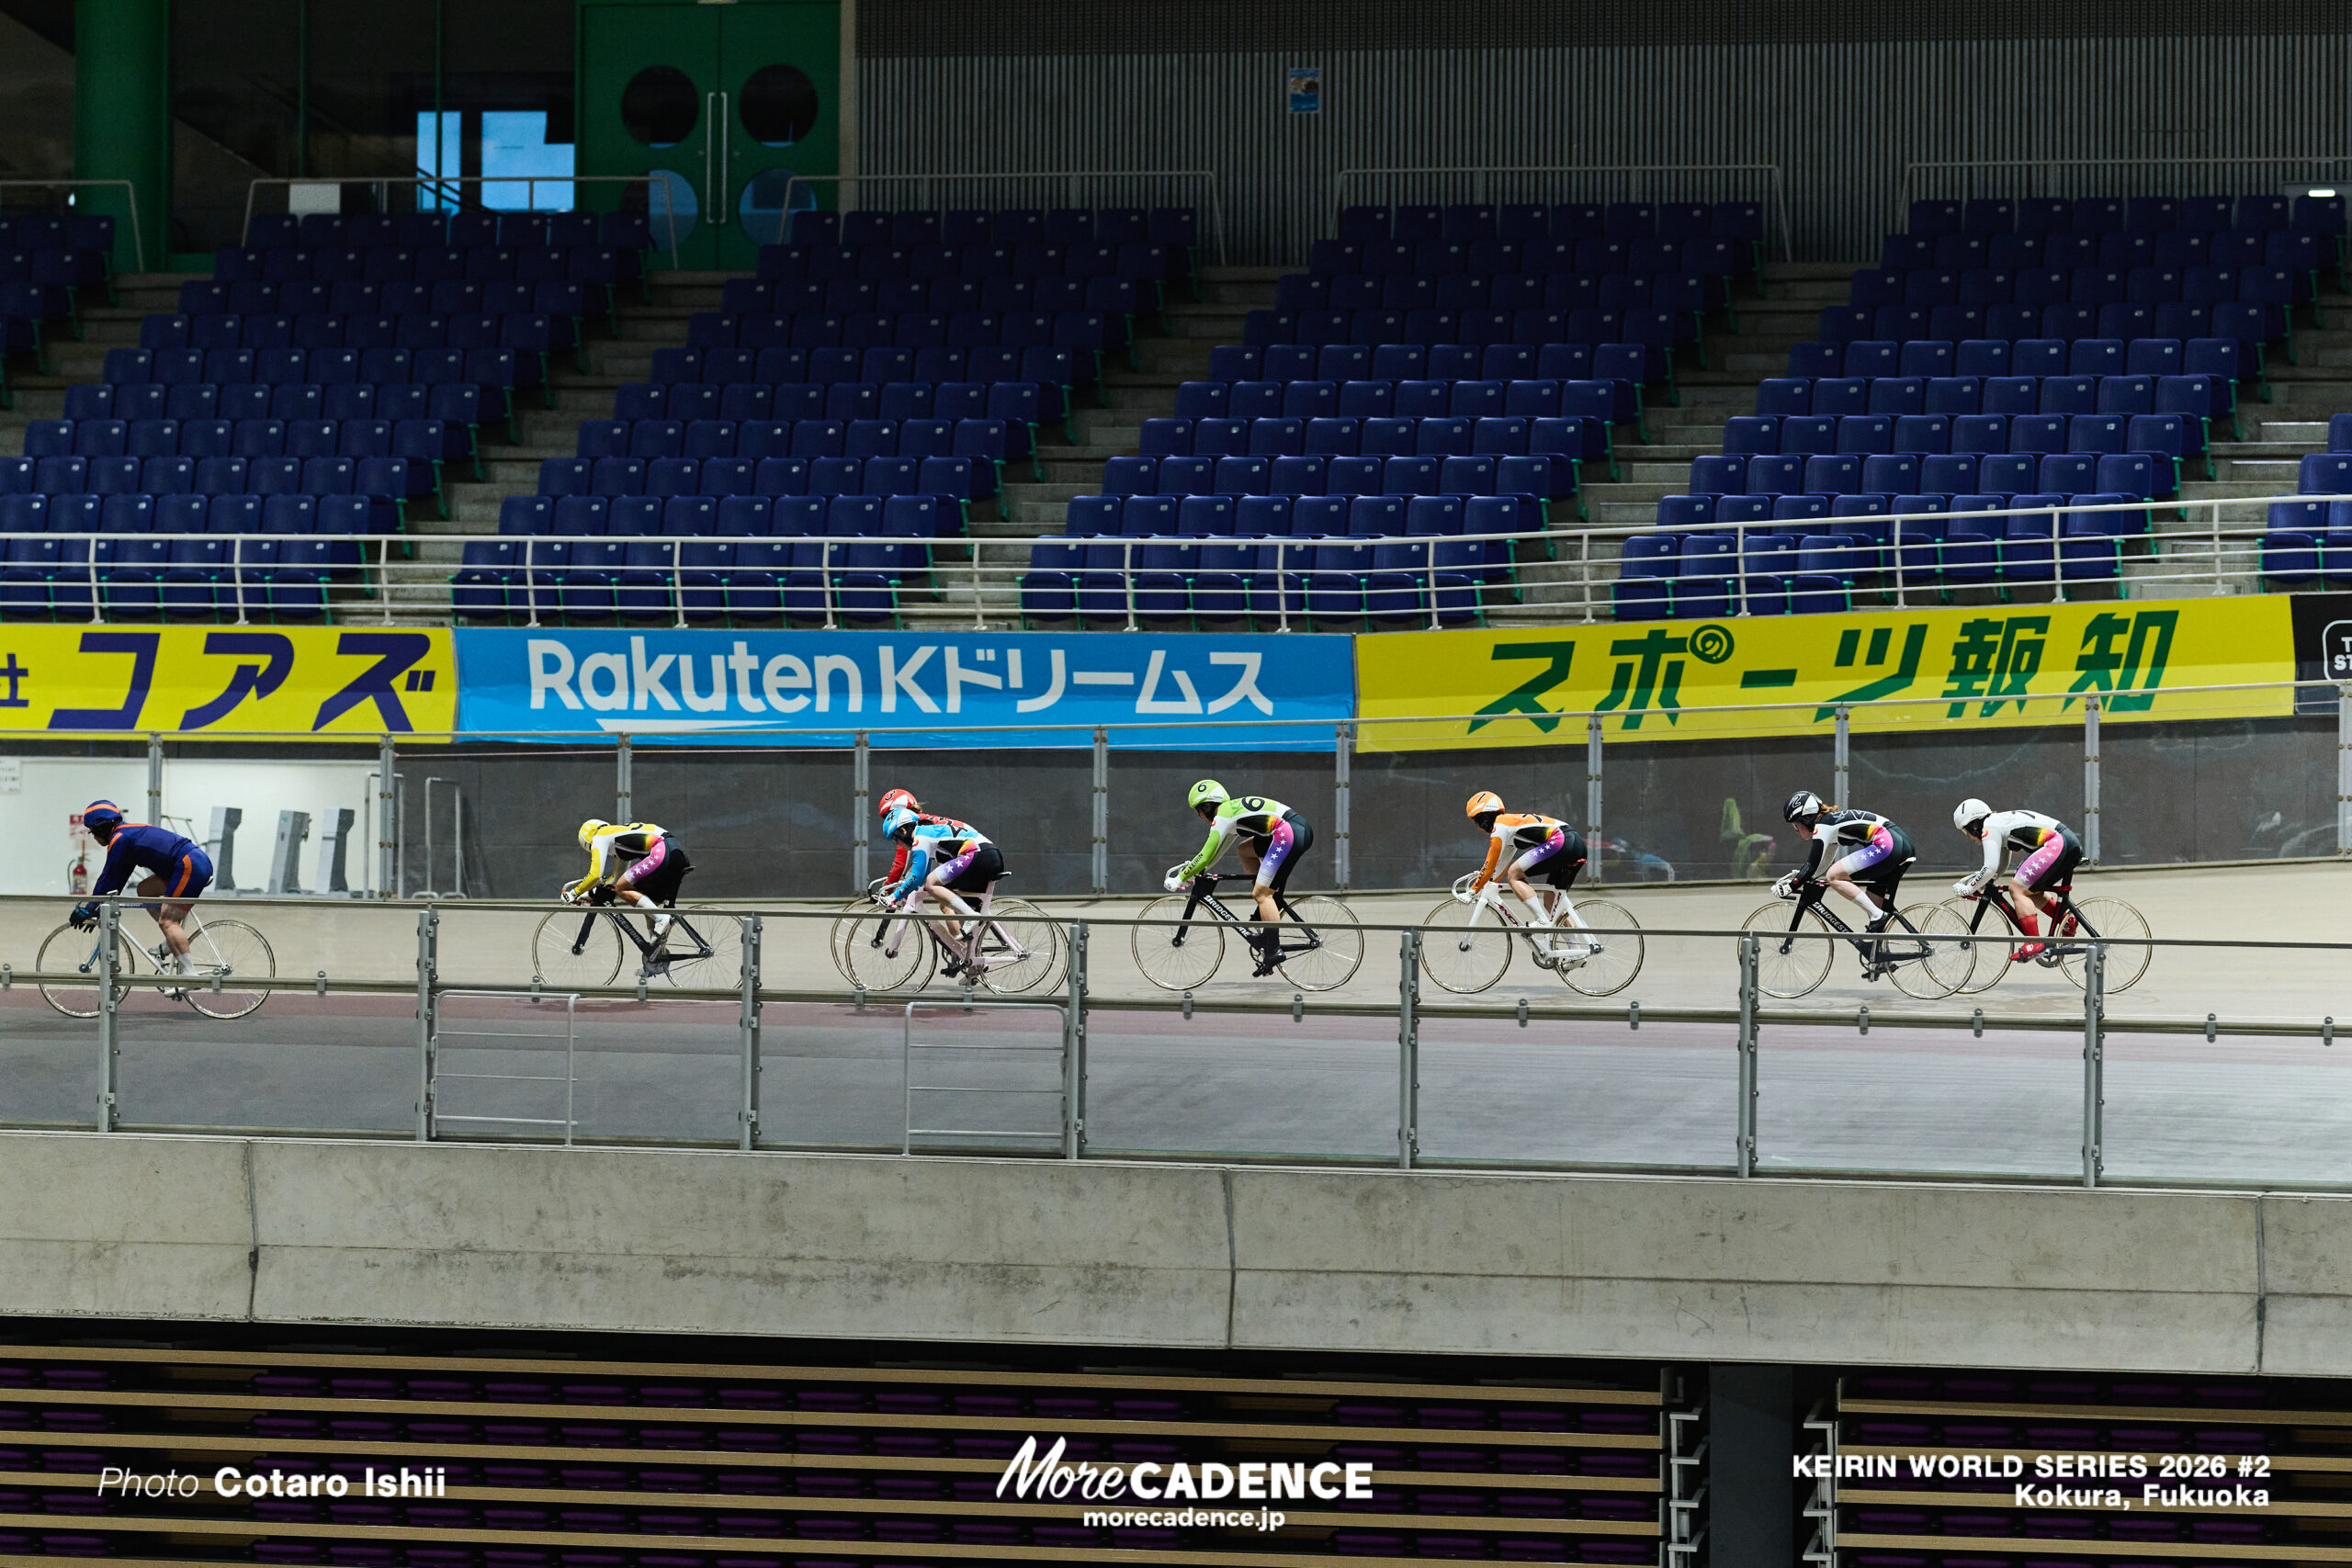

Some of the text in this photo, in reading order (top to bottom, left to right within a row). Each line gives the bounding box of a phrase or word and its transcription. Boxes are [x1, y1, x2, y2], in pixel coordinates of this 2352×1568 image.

[527, 636, 1274, 716] Rakuten Kドリームス
[1468, 610, 2179, 735] スポーツ報知
[1240, 796, 1266, 812] 6
[1204, 895, 1250, 937] BRIDGESNE
